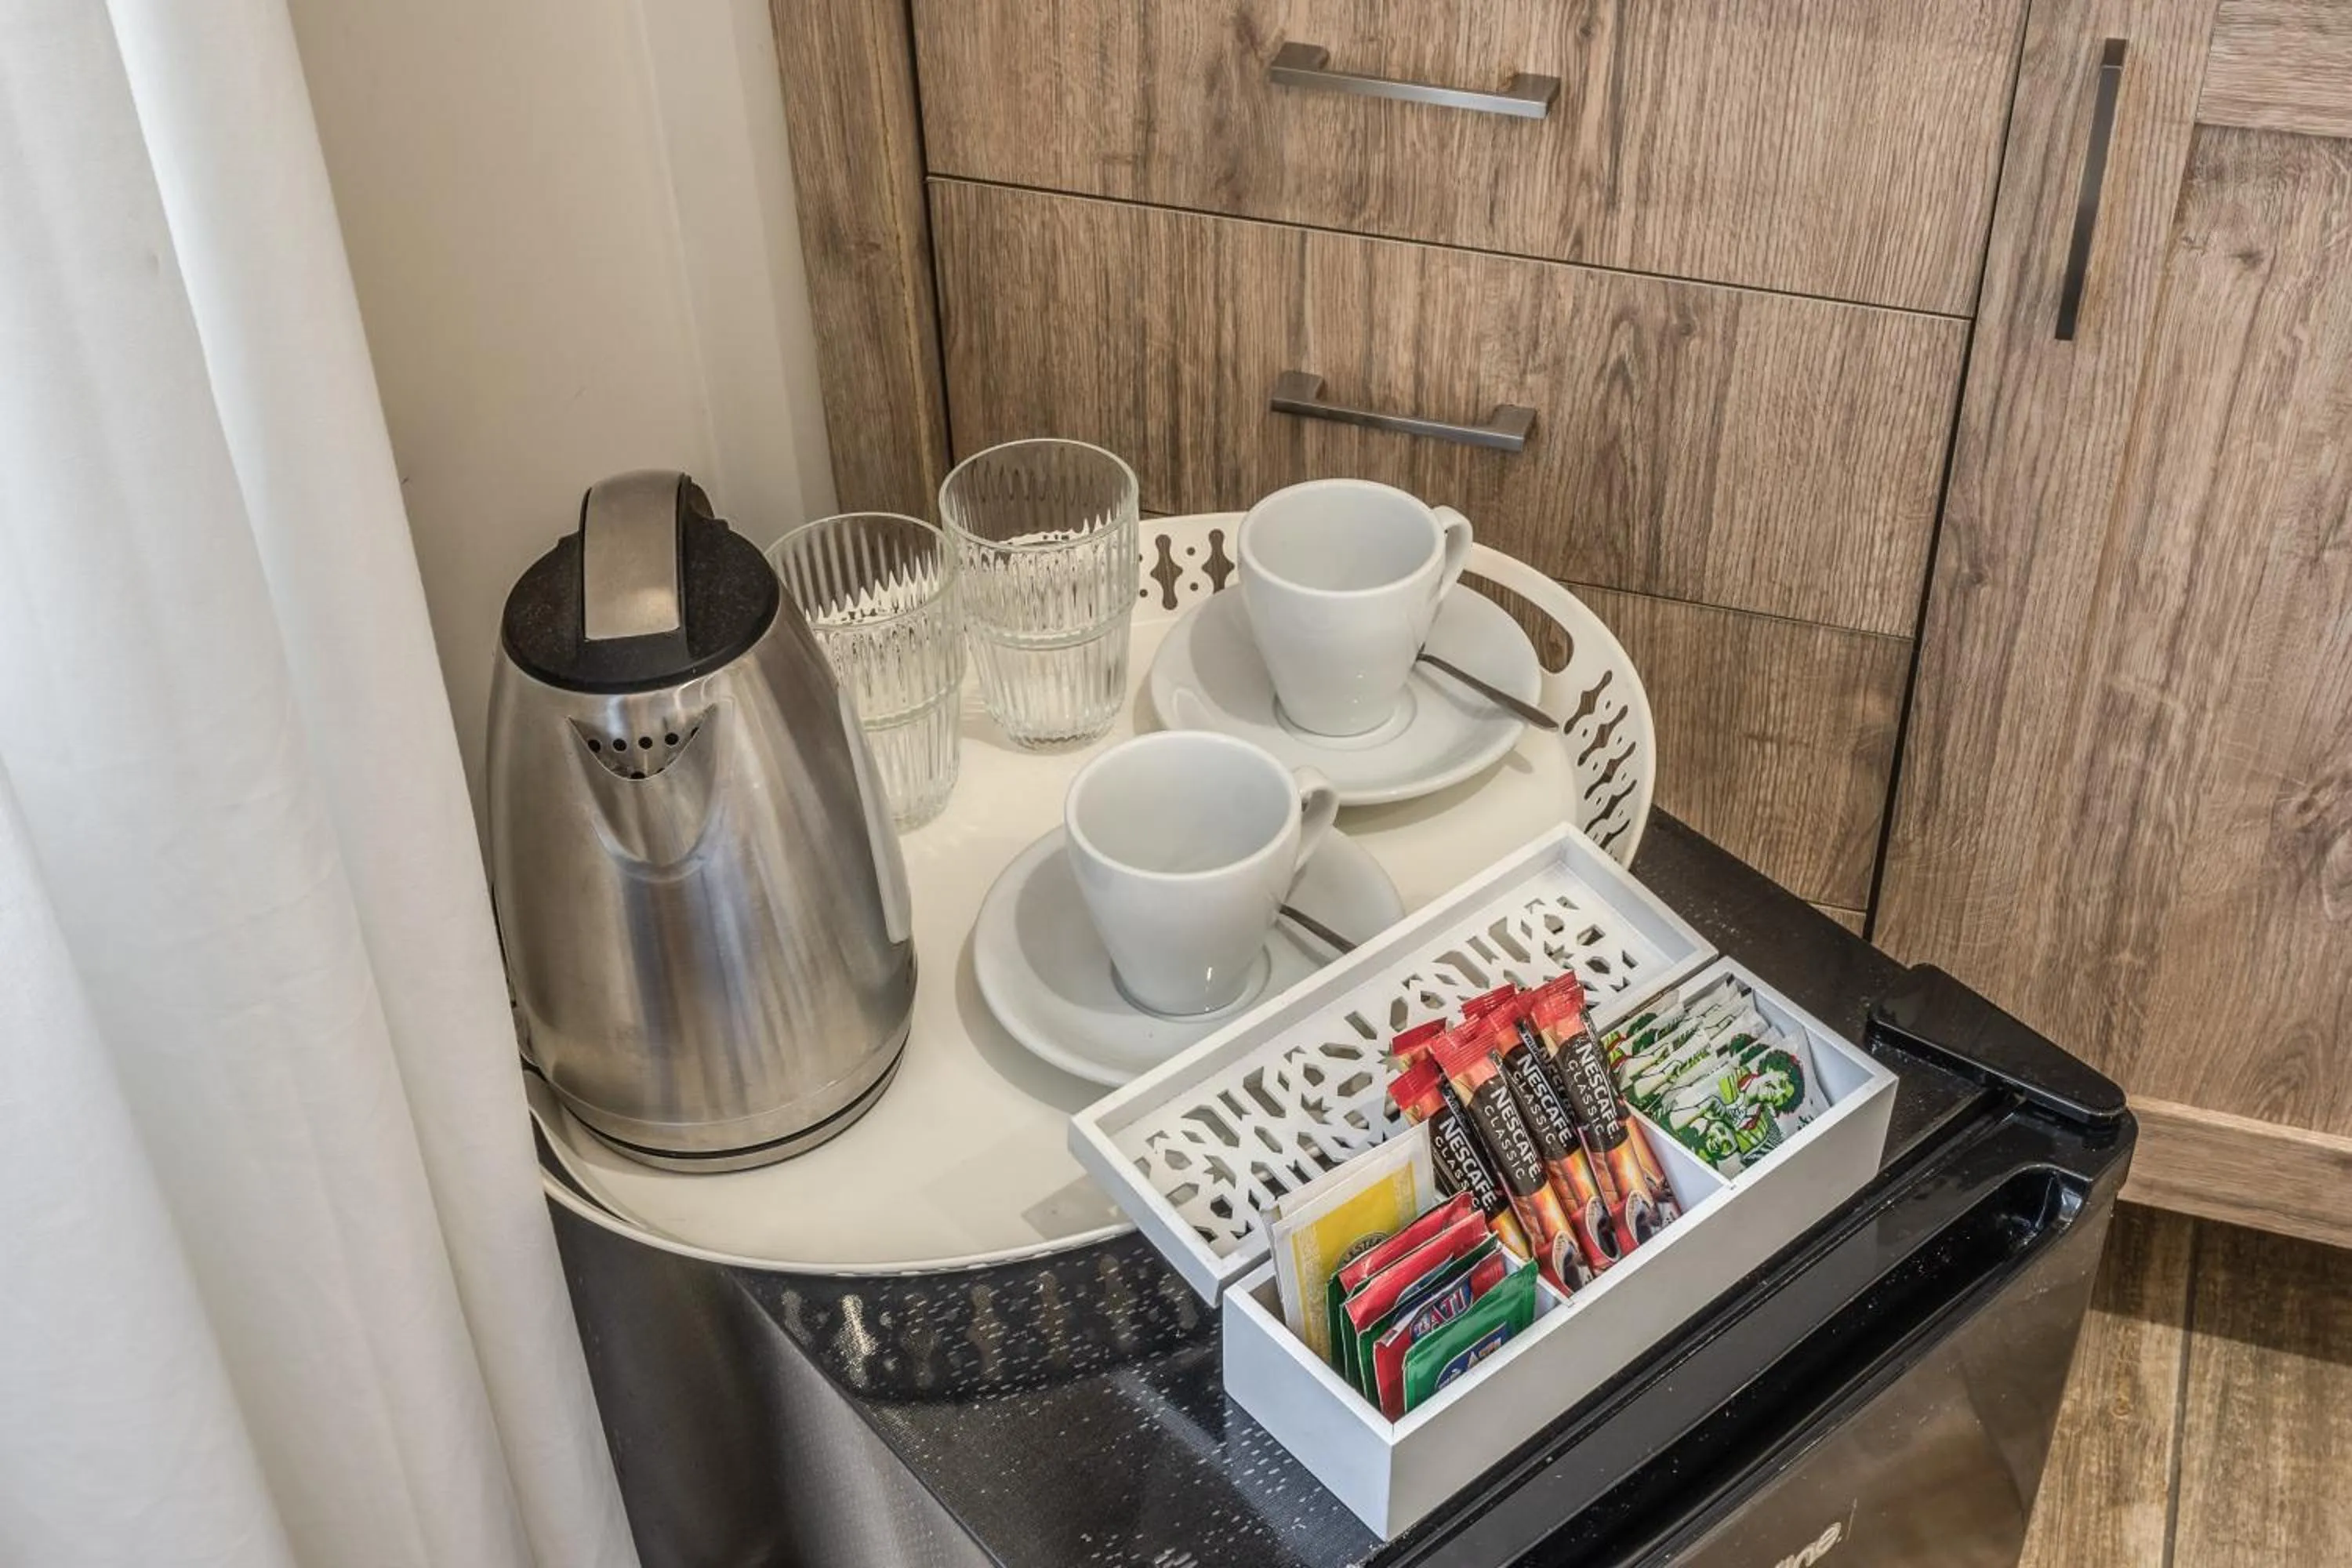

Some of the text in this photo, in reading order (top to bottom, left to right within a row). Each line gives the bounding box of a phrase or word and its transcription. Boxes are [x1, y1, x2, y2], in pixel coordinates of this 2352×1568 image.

[1513, 1071, 1555, 1145] CLASSIC
[1568, 1059, 1604, 1135] CLASSIC
[1435, 1136, 1479, 1207] CLASSC
[1484, 1104, 1525, 1180] CLASSIC
